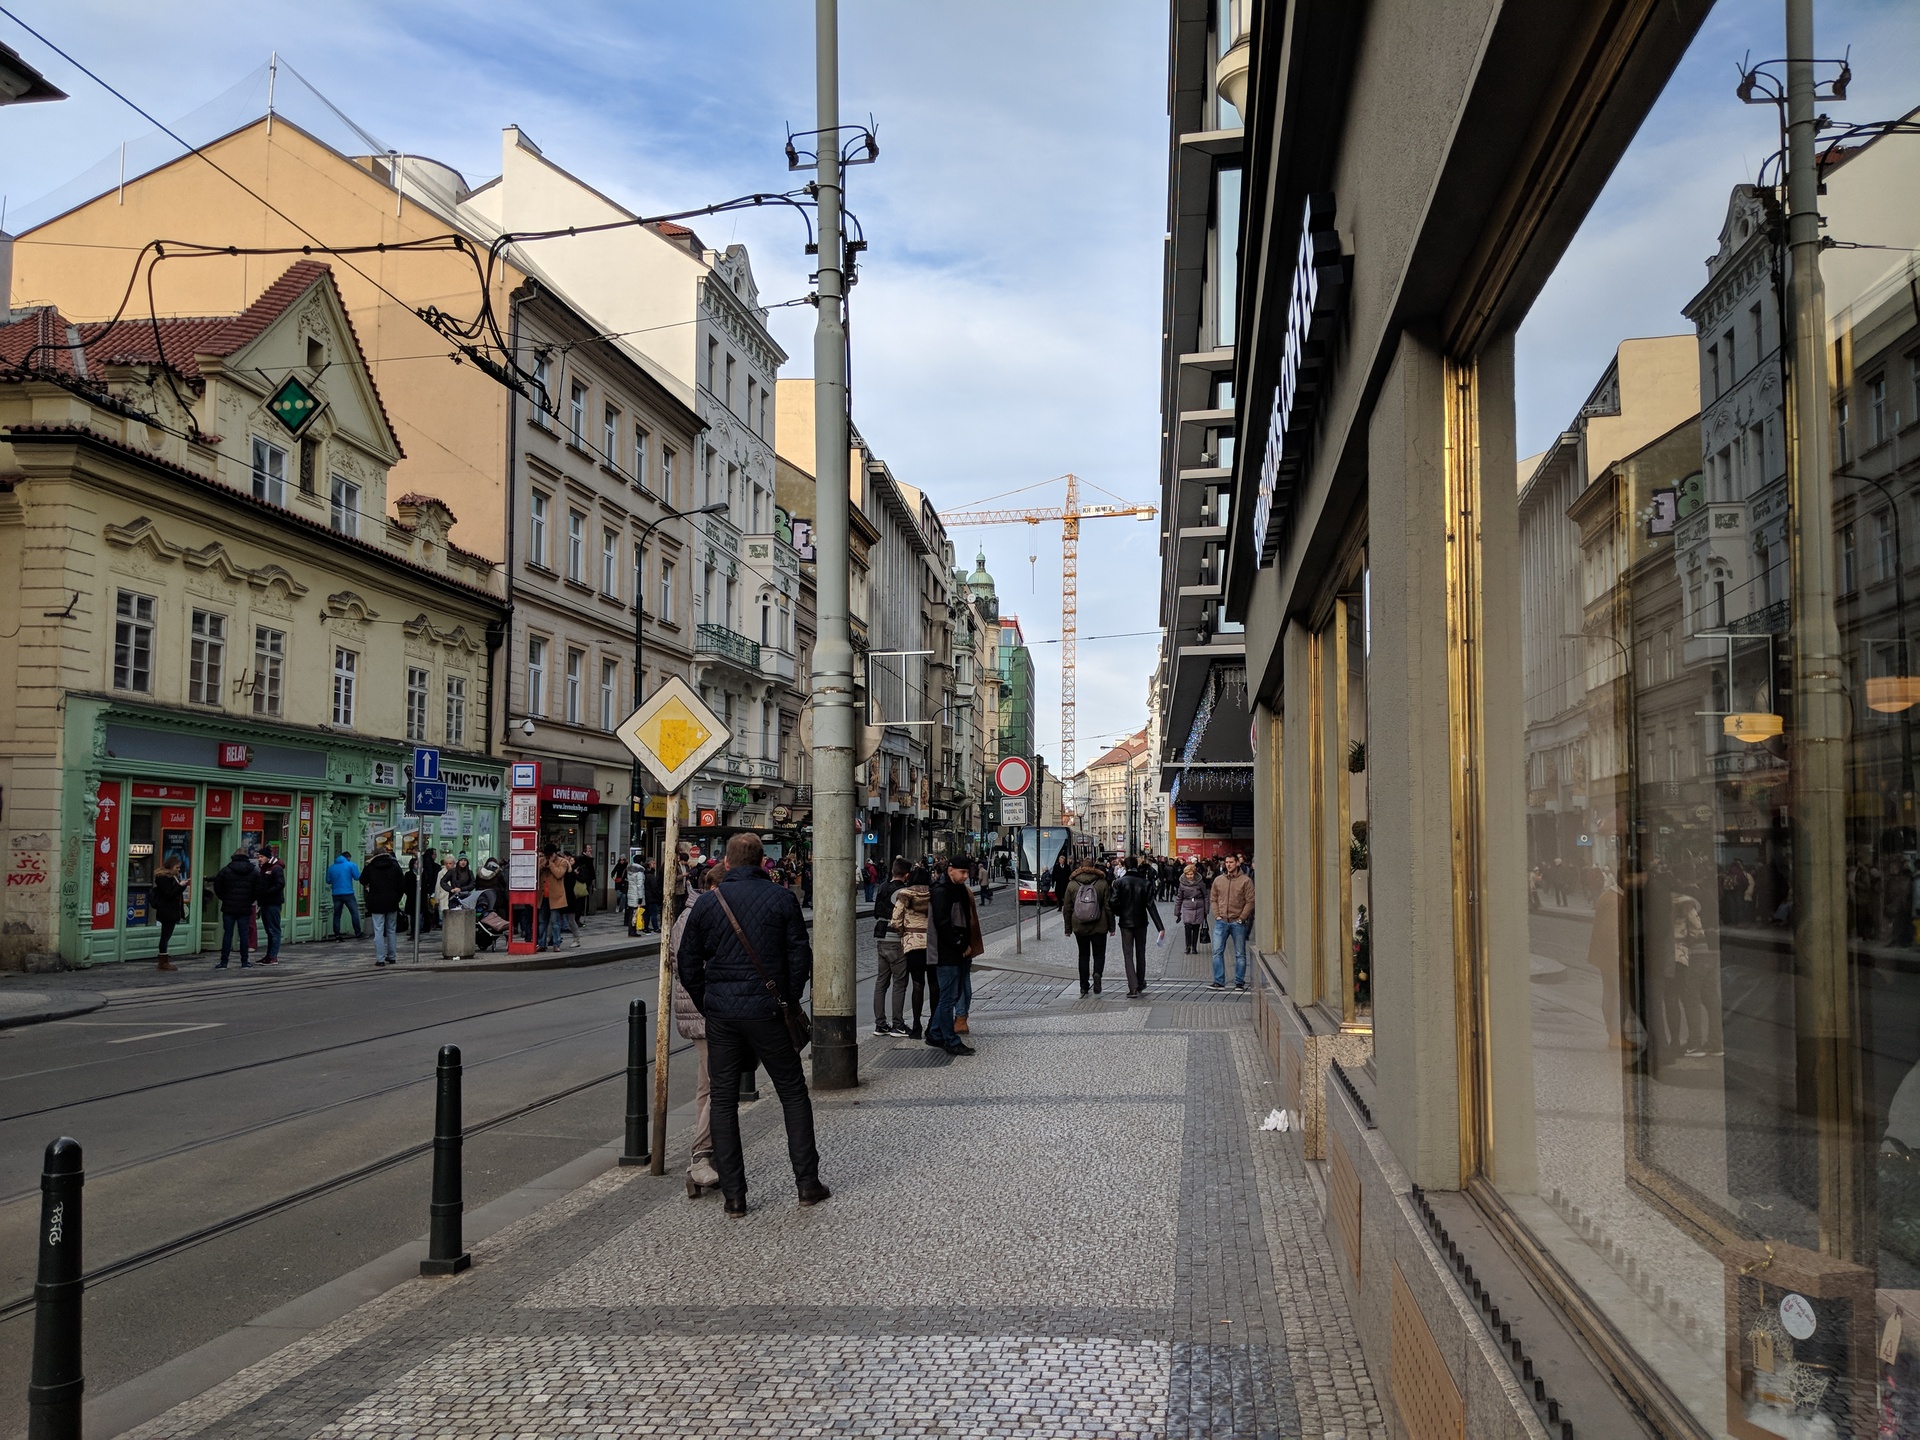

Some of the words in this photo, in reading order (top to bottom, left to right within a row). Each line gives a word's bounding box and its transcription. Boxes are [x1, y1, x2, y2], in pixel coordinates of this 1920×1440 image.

[1281, 194, 1318, 433] COFFEE
[226, 745, 247, 763] RELAY
[437, 770, 489, 788] ATNICTVÍ
[553, 787, 570, 800] LEVNÉ
[571, 790, 588, 802] KNIHY
[170, 813, 186, 822] Tabák
[132, 845, 150, 854] ATM
